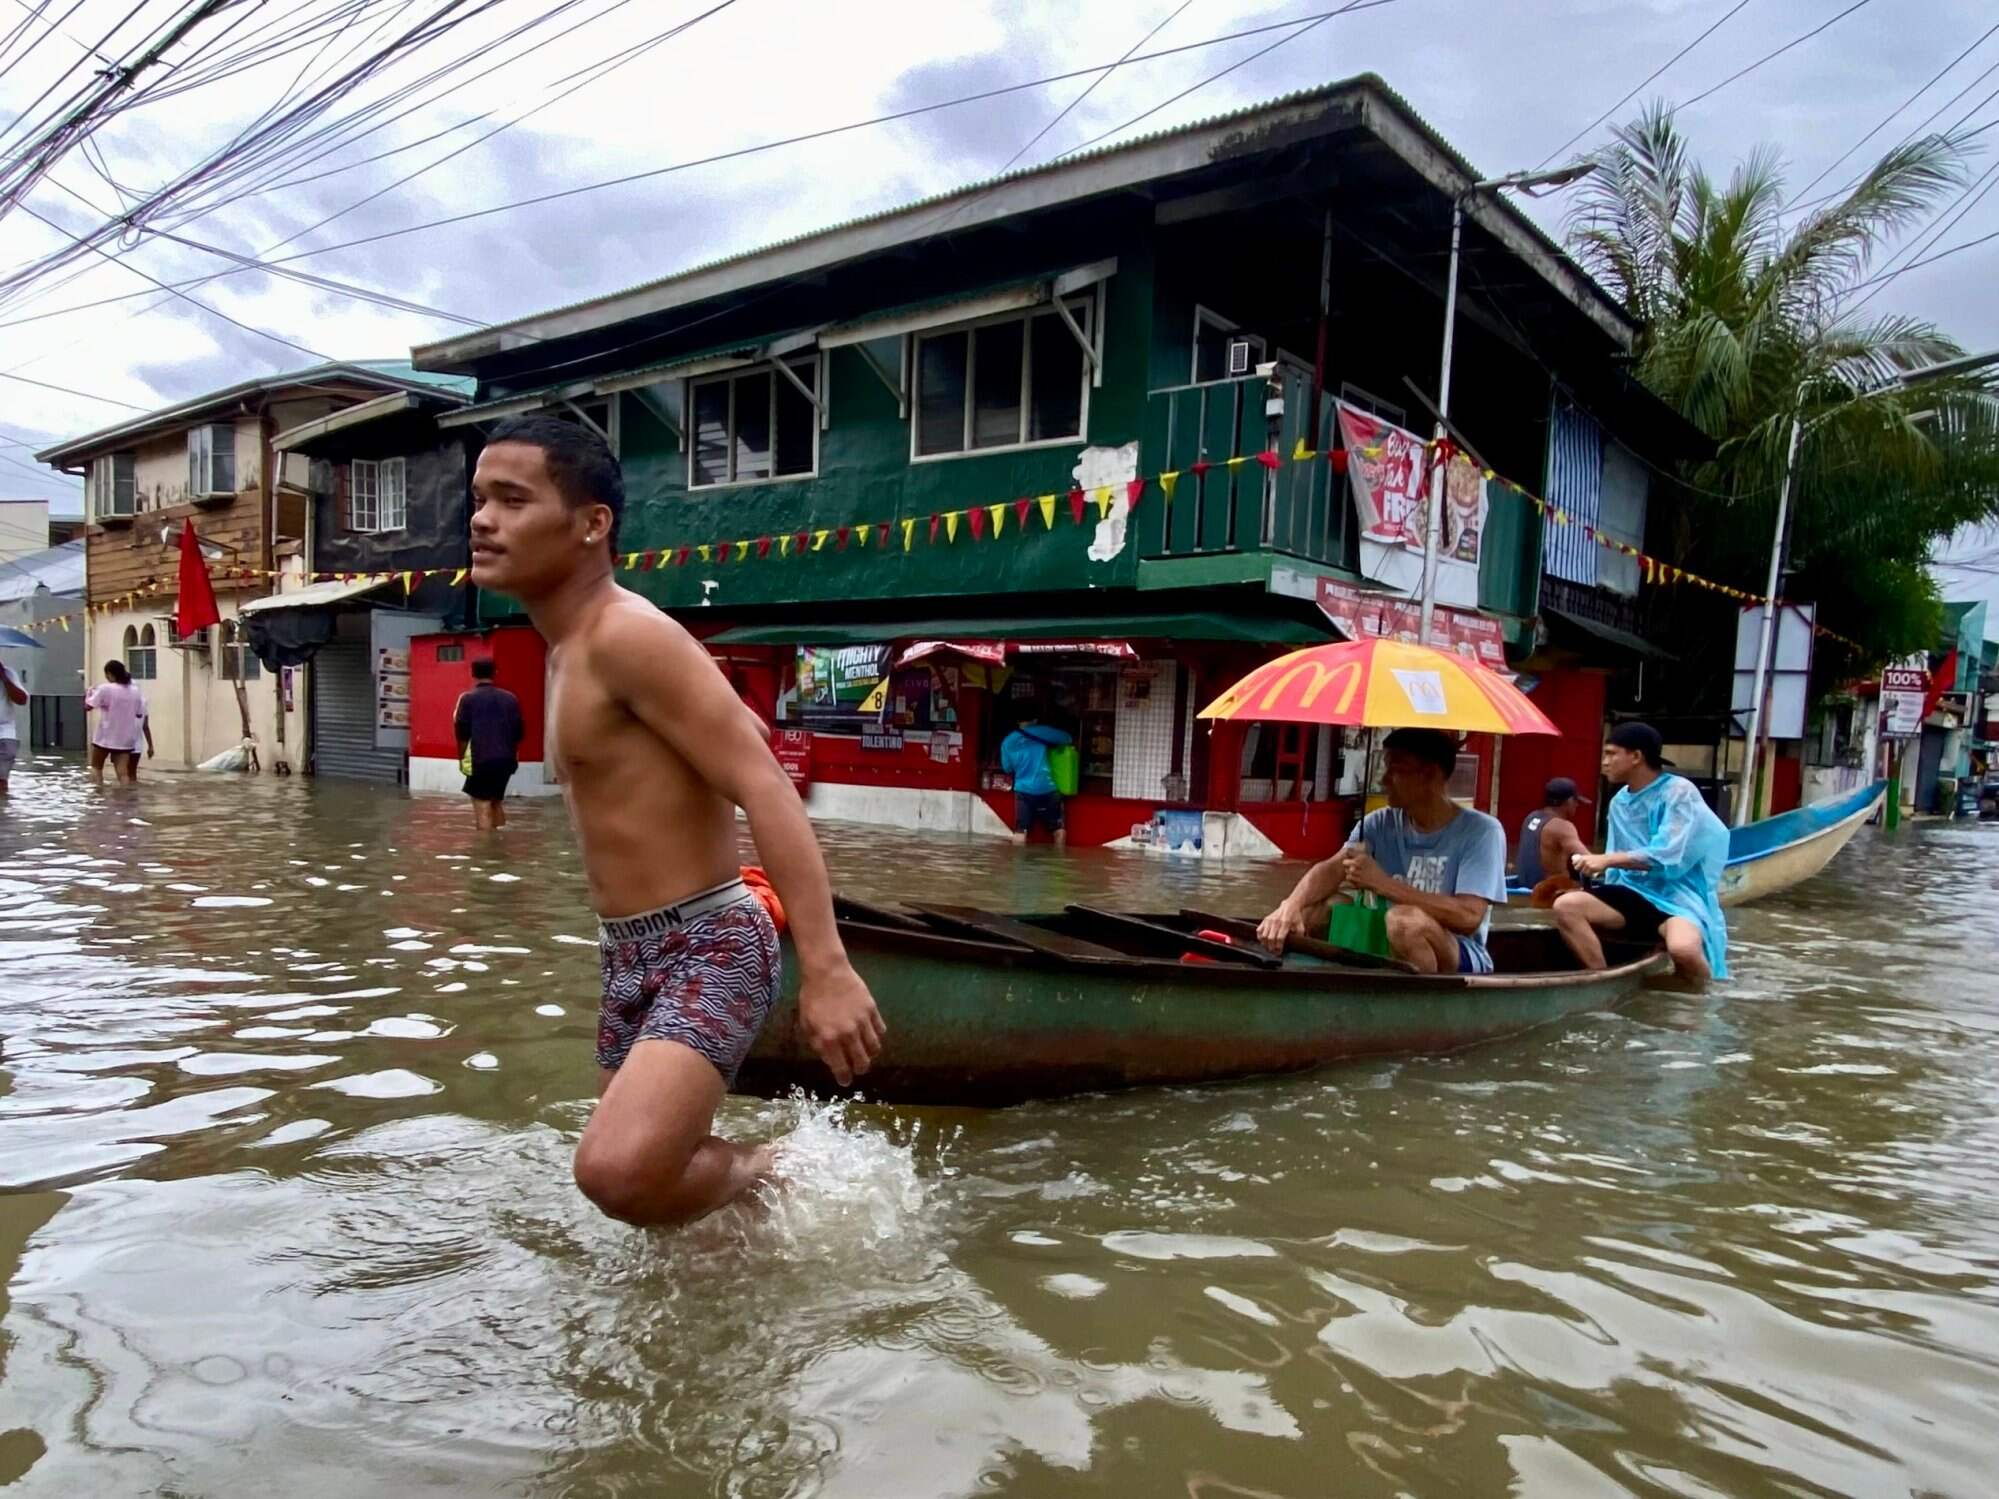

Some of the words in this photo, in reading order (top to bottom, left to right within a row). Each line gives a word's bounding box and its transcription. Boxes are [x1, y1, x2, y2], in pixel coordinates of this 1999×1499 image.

[837, 645, 880, 671] MIGHTY
[844, 663, 880, 680] MENTHOL
[1887, 672, 1922, 686] 100%
